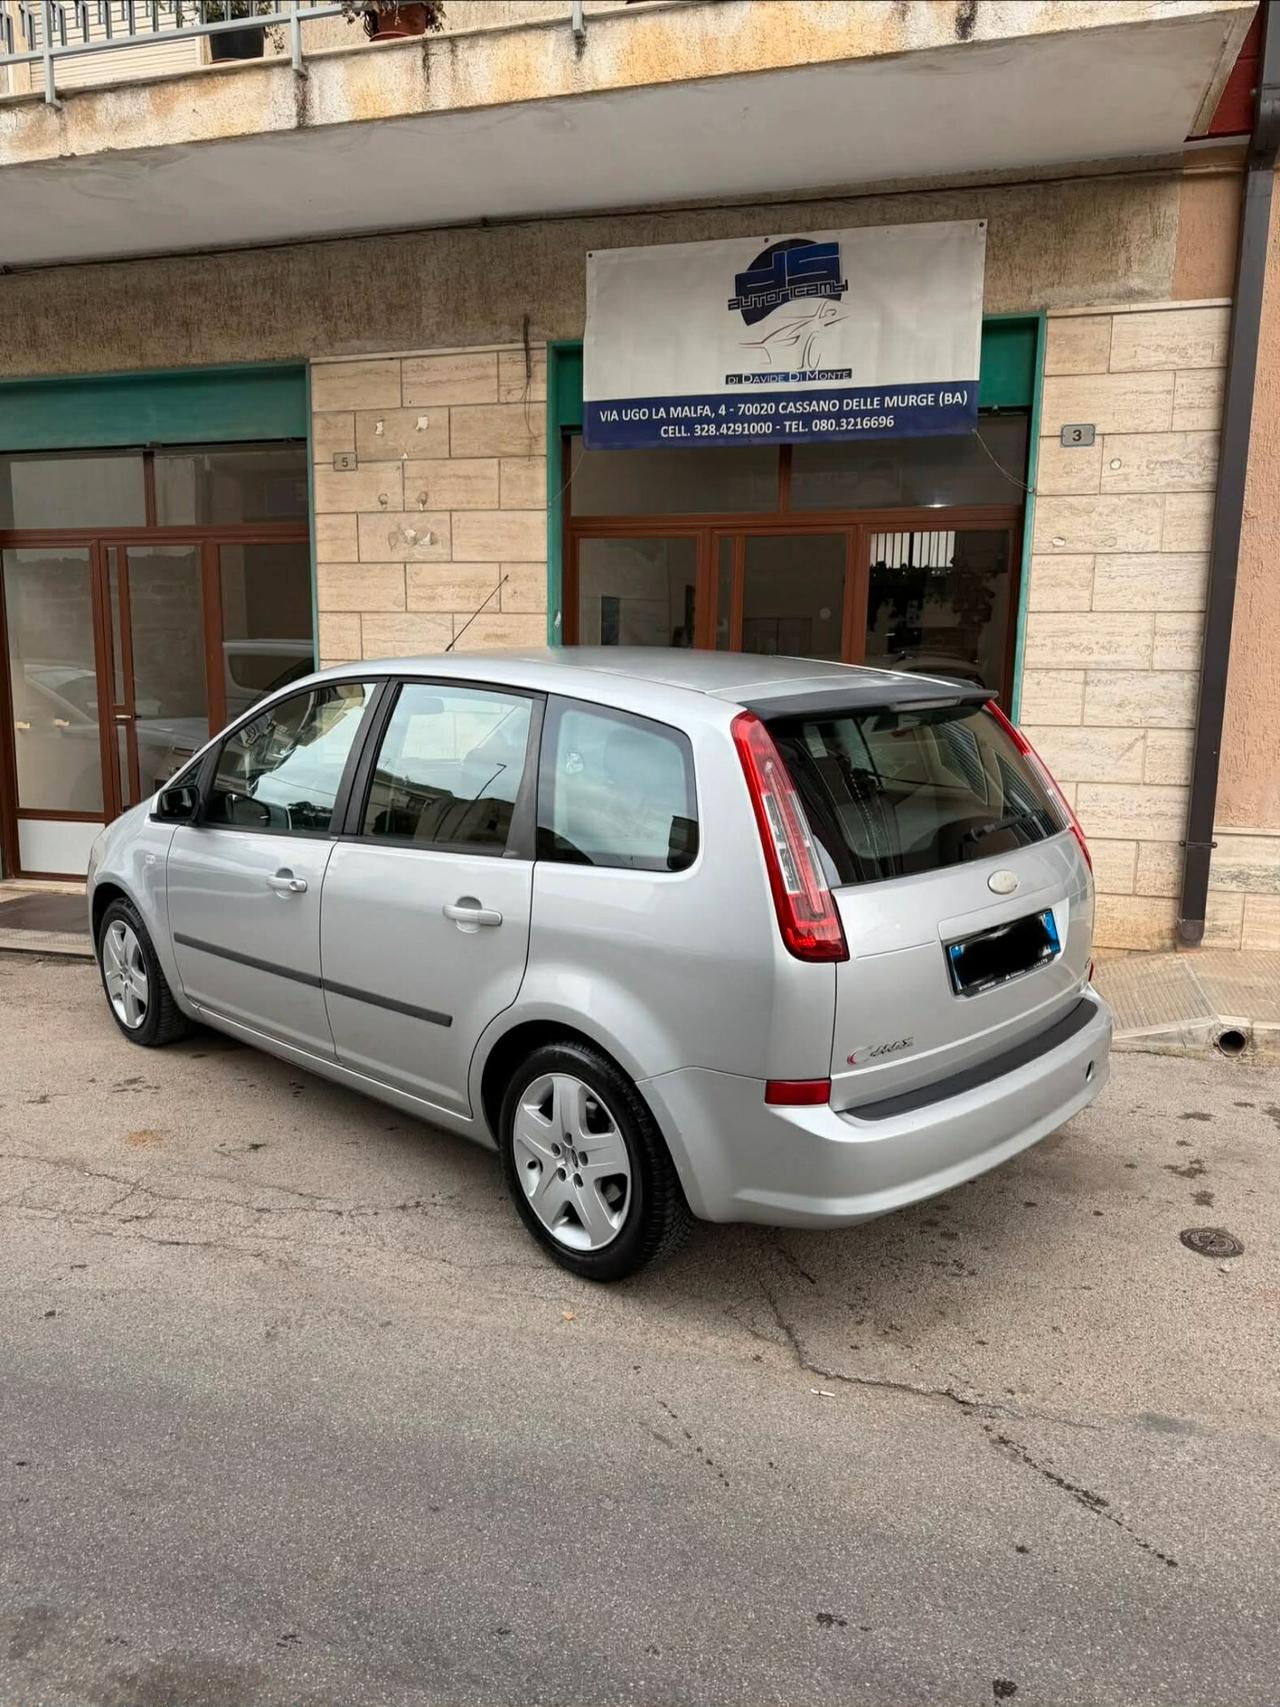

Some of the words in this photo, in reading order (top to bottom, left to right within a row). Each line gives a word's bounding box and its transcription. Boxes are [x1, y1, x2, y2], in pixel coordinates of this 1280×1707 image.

[742, 373, 786, 384] DAVIDE
[806, 370, 850, 381] MONTE
[600, 411, 619, 422] VIA
[622, 408, 649, 421] UGO
[652, 407, 666, 419] LA
[670, 405, 715, 418] MALFA,
[718, 404, 727, 416] 4
[737, 402, 775, 416] 70020
[778, 400, 839, 414] CASSANO
[843, 397, 880, 411] DELLE
[884, 394, 935, 408] MURGE
[939, 390, 968, 407] (BA)
[660, 425, 691, 437] CELL.
[694, 422, 772, 437] 328.4291000
[784, 420, 809, 433] TEL.
[812, 416, 895, 431] 080.3216696
[1072, 429, 1082, 442] 3
[342, 457, 348, 467] 5
